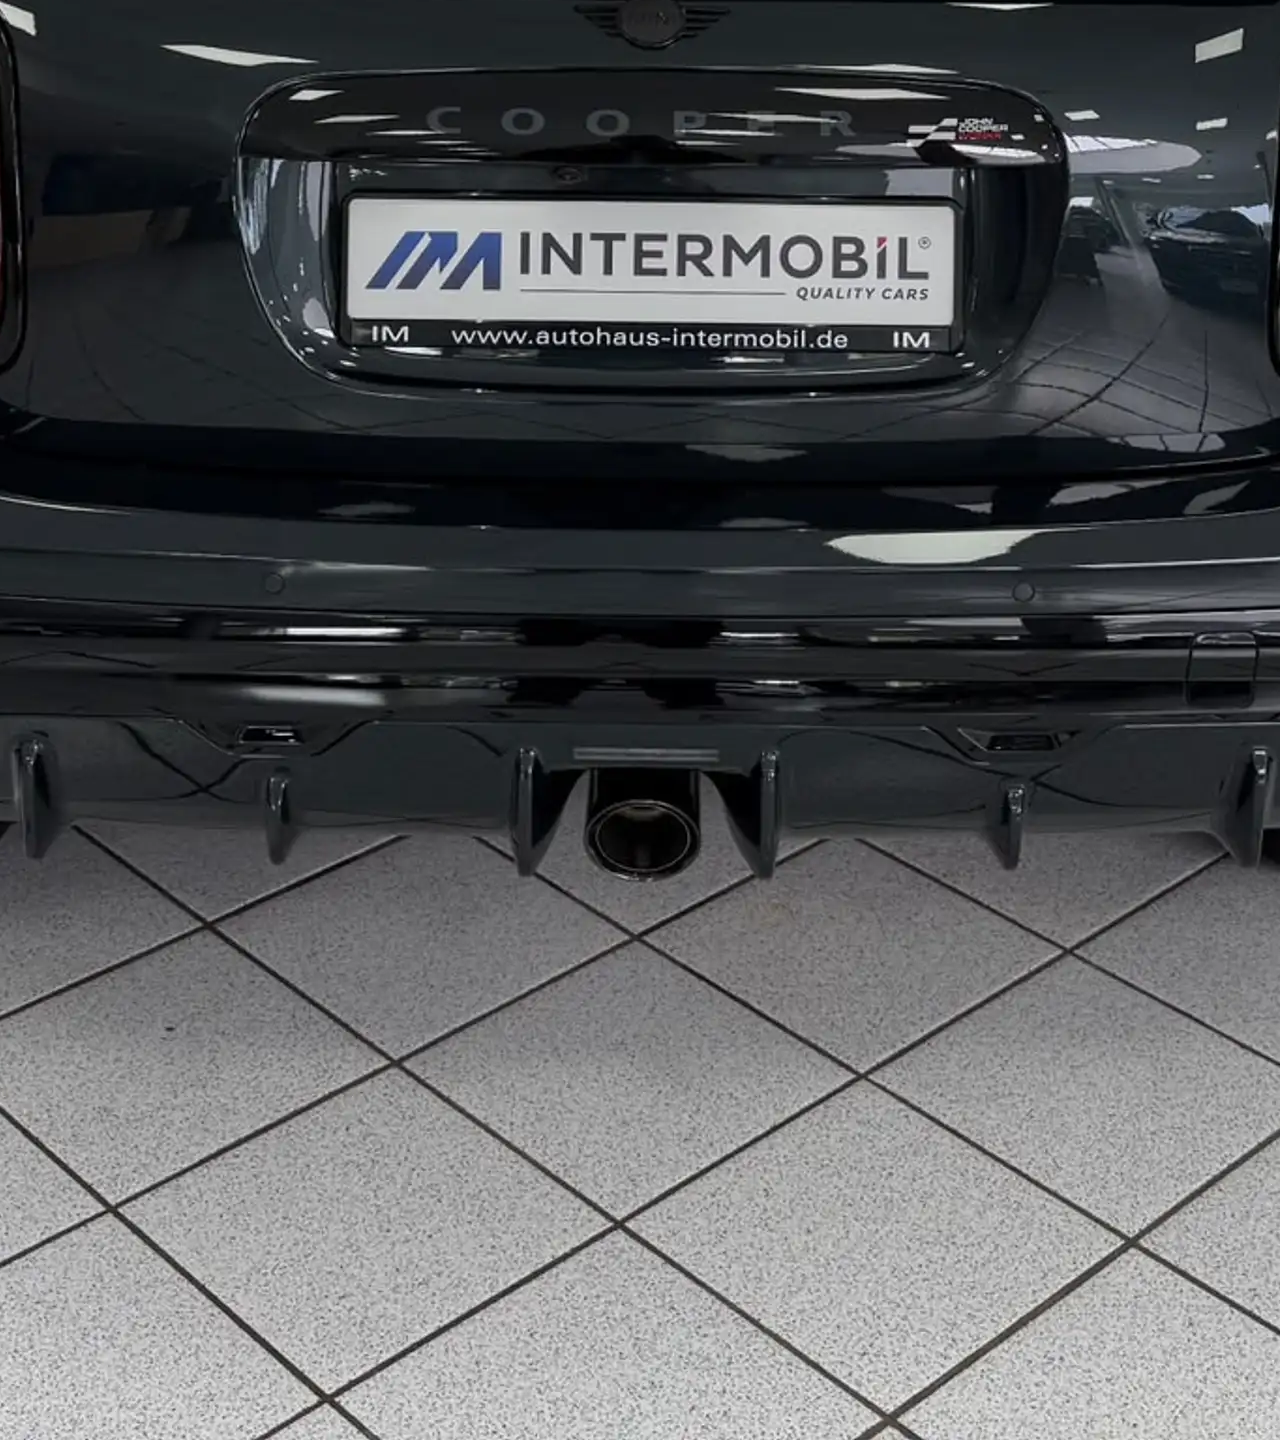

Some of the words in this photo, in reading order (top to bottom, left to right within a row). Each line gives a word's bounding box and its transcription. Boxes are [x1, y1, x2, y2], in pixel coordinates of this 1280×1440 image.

[426, 106, 856, 137] COOPER
[796, 286, 875, 301] QUALITY
[881, 288, 929, 301] CARS
[372, 325, 409, 343] IM
[451, 326, 848, 349] www.autohaus-intermobil.de
[893, 330, 930, 349] IM
